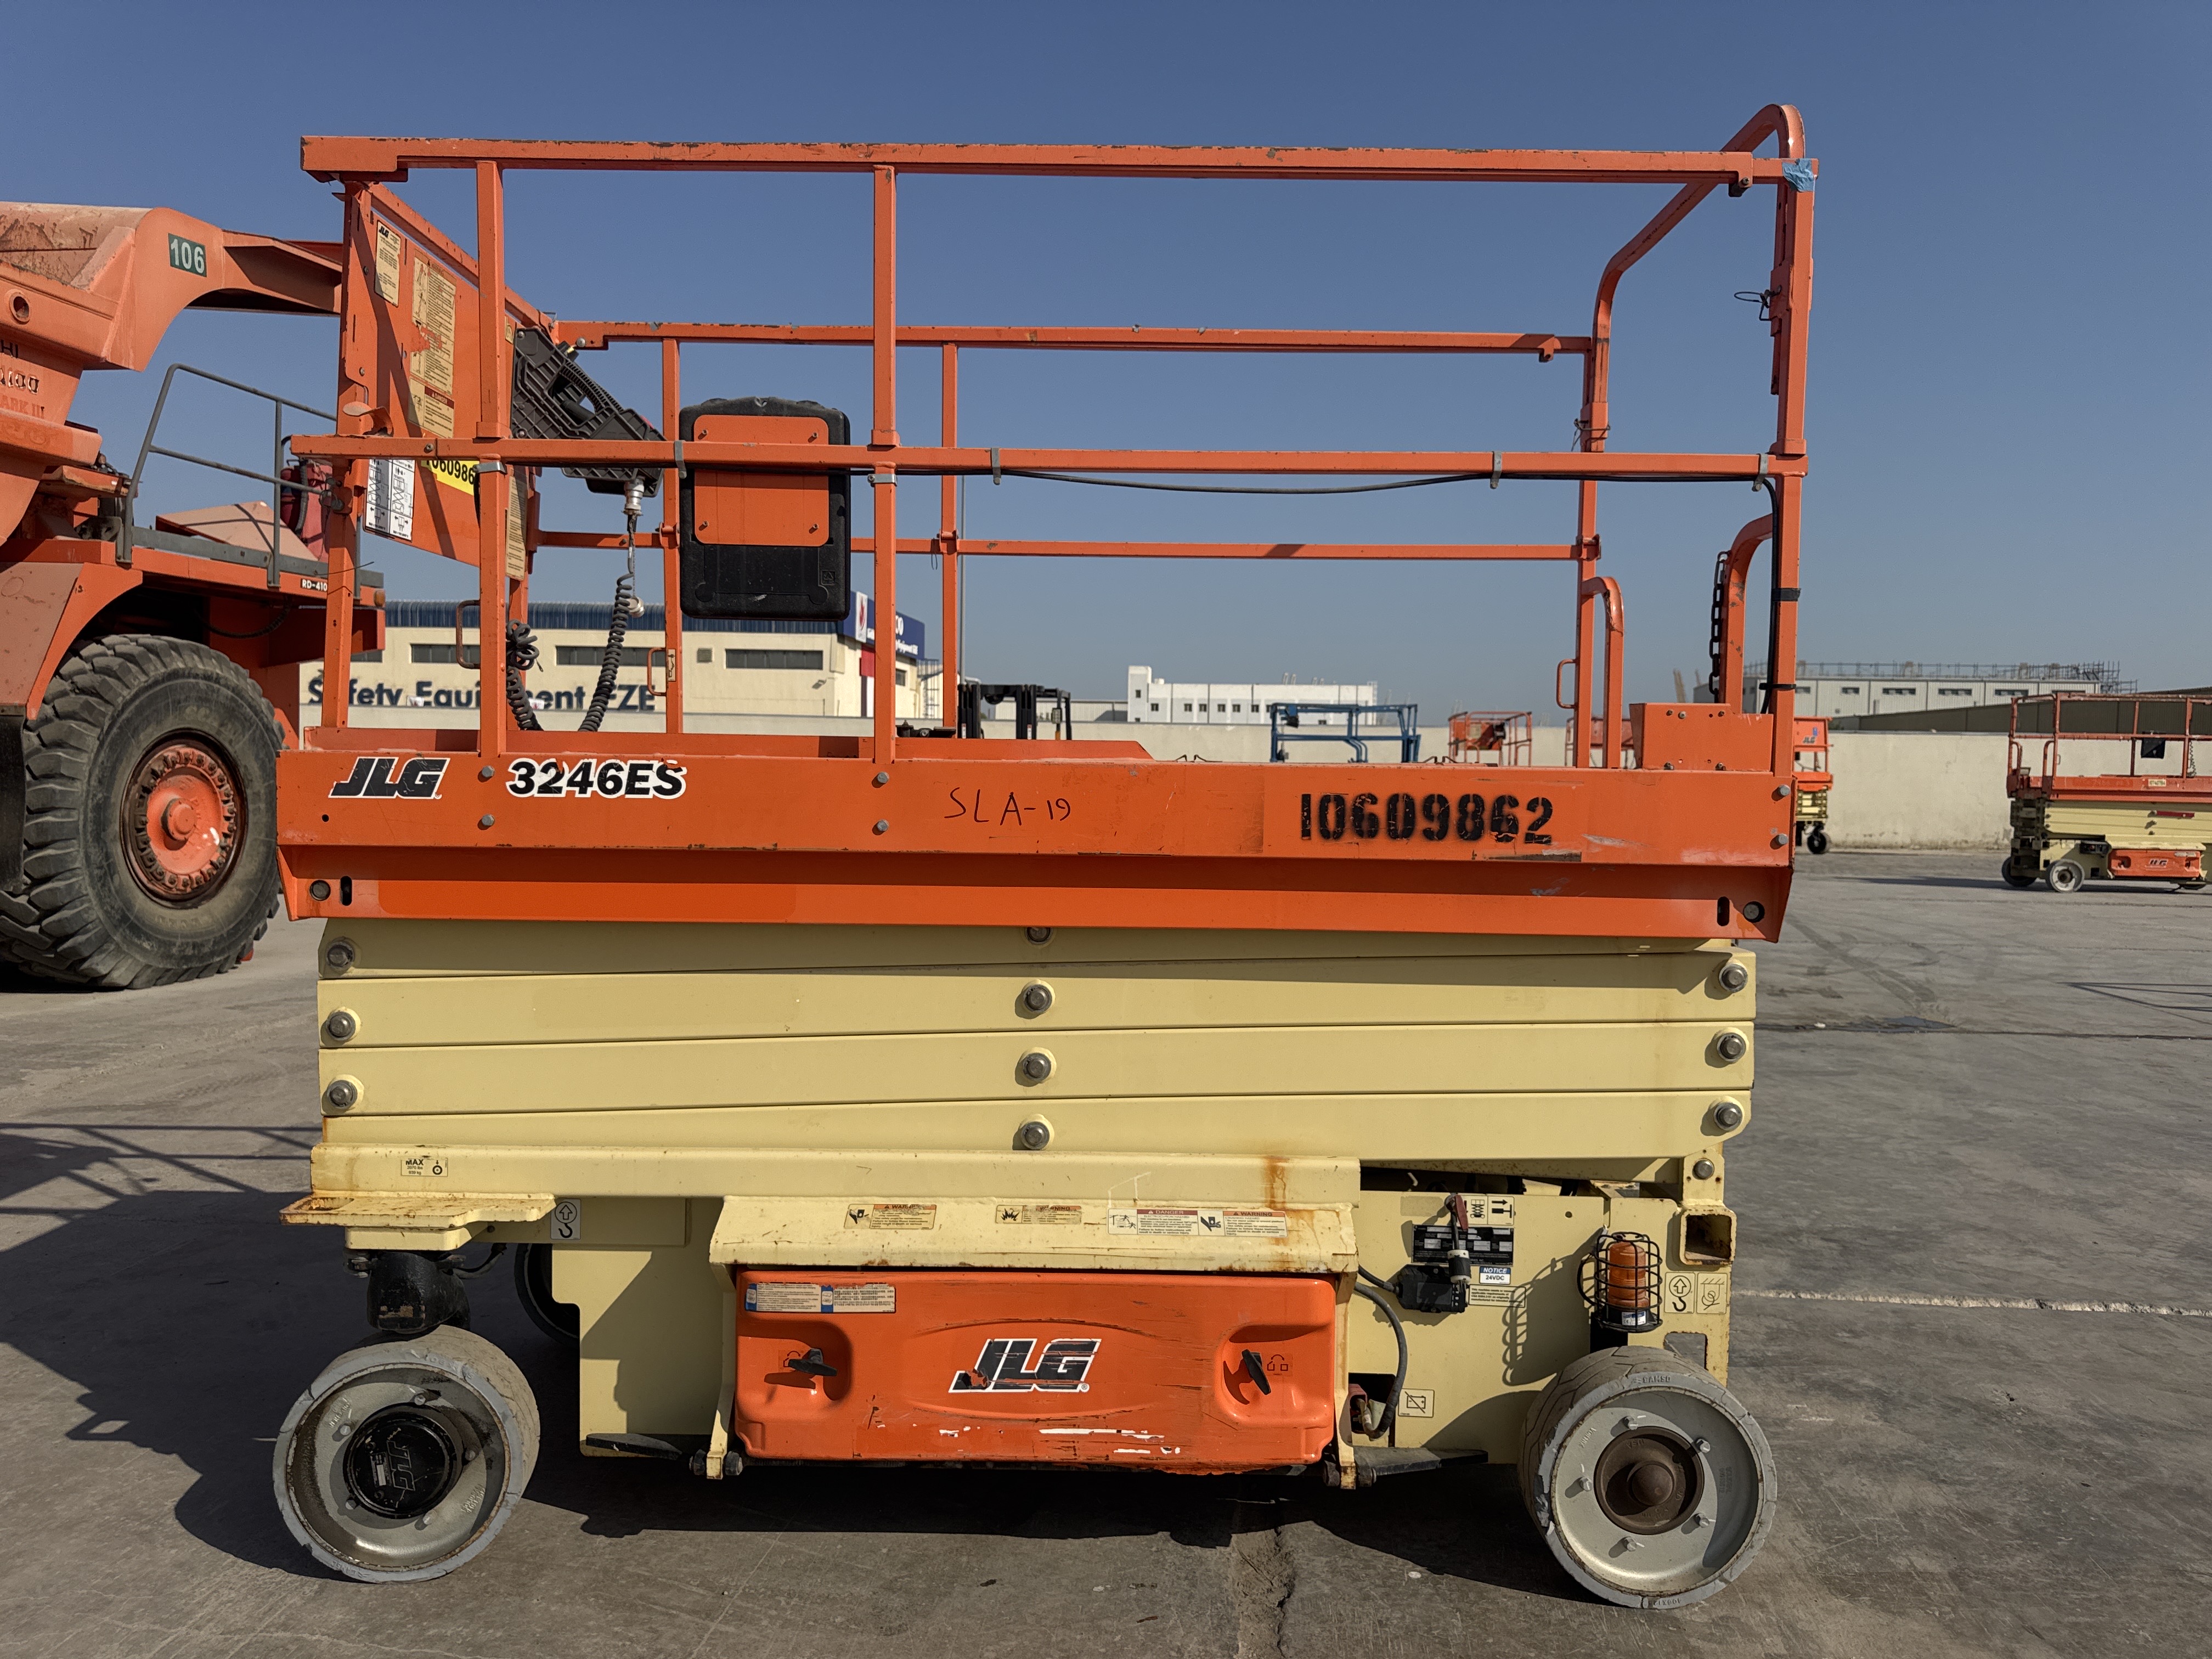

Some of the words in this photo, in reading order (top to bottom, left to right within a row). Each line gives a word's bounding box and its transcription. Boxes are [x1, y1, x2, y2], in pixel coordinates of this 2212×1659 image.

[171, 239, 205, 273] 106
[308, 678, 403, 707] Sfety
[328, 757, 450, 799] JLG
[506, 758, 687, 799] 3246ES
[1301, 793, 1554, 844] 10609862
[949, 1338, 1101, 1393] JLG
[387, 1440, 415, 1491] JLG
